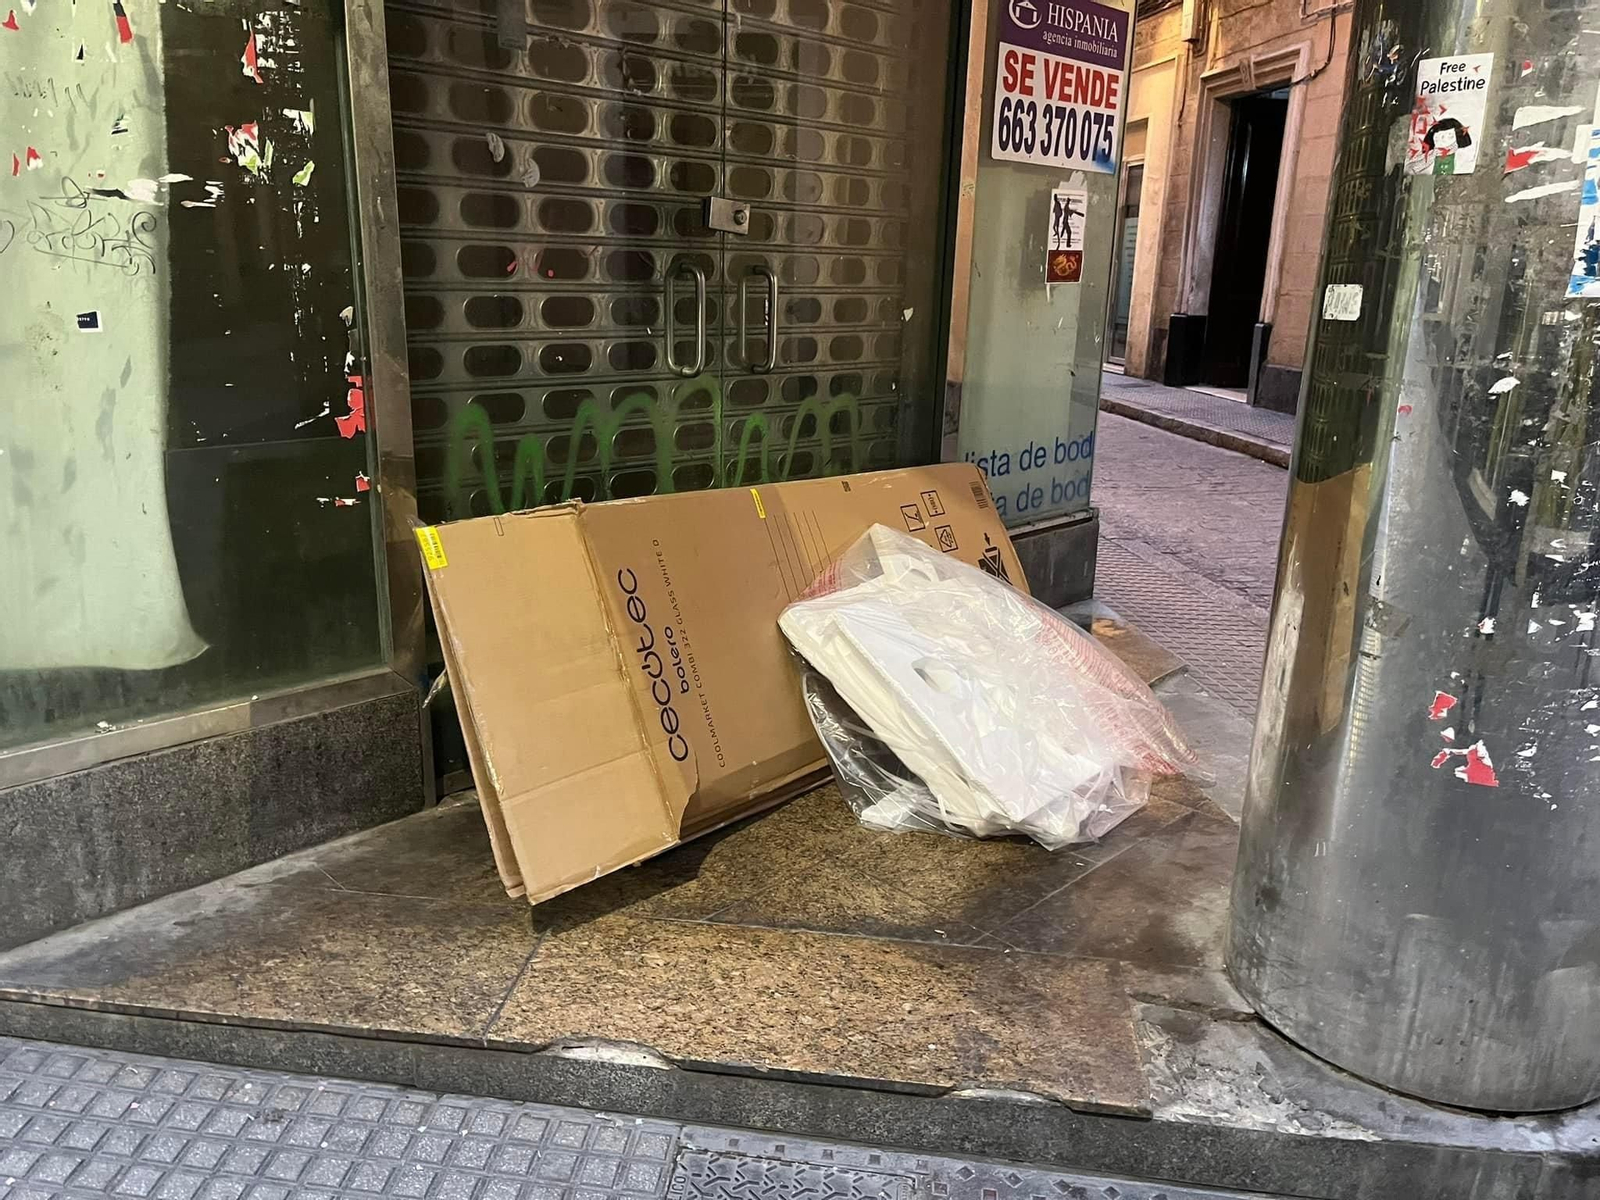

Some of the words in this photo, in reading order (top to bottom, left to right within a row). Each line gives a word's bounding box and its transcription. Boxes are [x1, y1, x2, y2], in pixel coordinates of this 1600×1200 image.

[1047, 2, 1118, 43] HISPANIA
[1042, 30, 1072, 45] agencia
[1074, 35, 1118, 58] inmobiliaria
[1003, 50, 1036, 96] SE
[1043, 58, 1119, 110] VENDE
[1420, 76, 1486, 96] Palestine
[1440, 62, 1466, 75] Free
[998, 96, 1038, 155] 663
[1040, 103, 1077, 159] 370
[1080, 109, 1115, 163] 075
[965, 450, 1010, 480] sta
[1019, 441, 1047, 471] de
[1054, 430, 1093, 464] bod
[655, 550, 671, 588] WHITE
[667, 590, 683, 625] GLASS
[680, 628, 692, 650] 322
[618, 568, 688, 761] cecotec
[664, 626, 690, 694] bolero
[687, 652, 703, 689] COMBI
[698, 693, 726, 768] COOLMARKET
